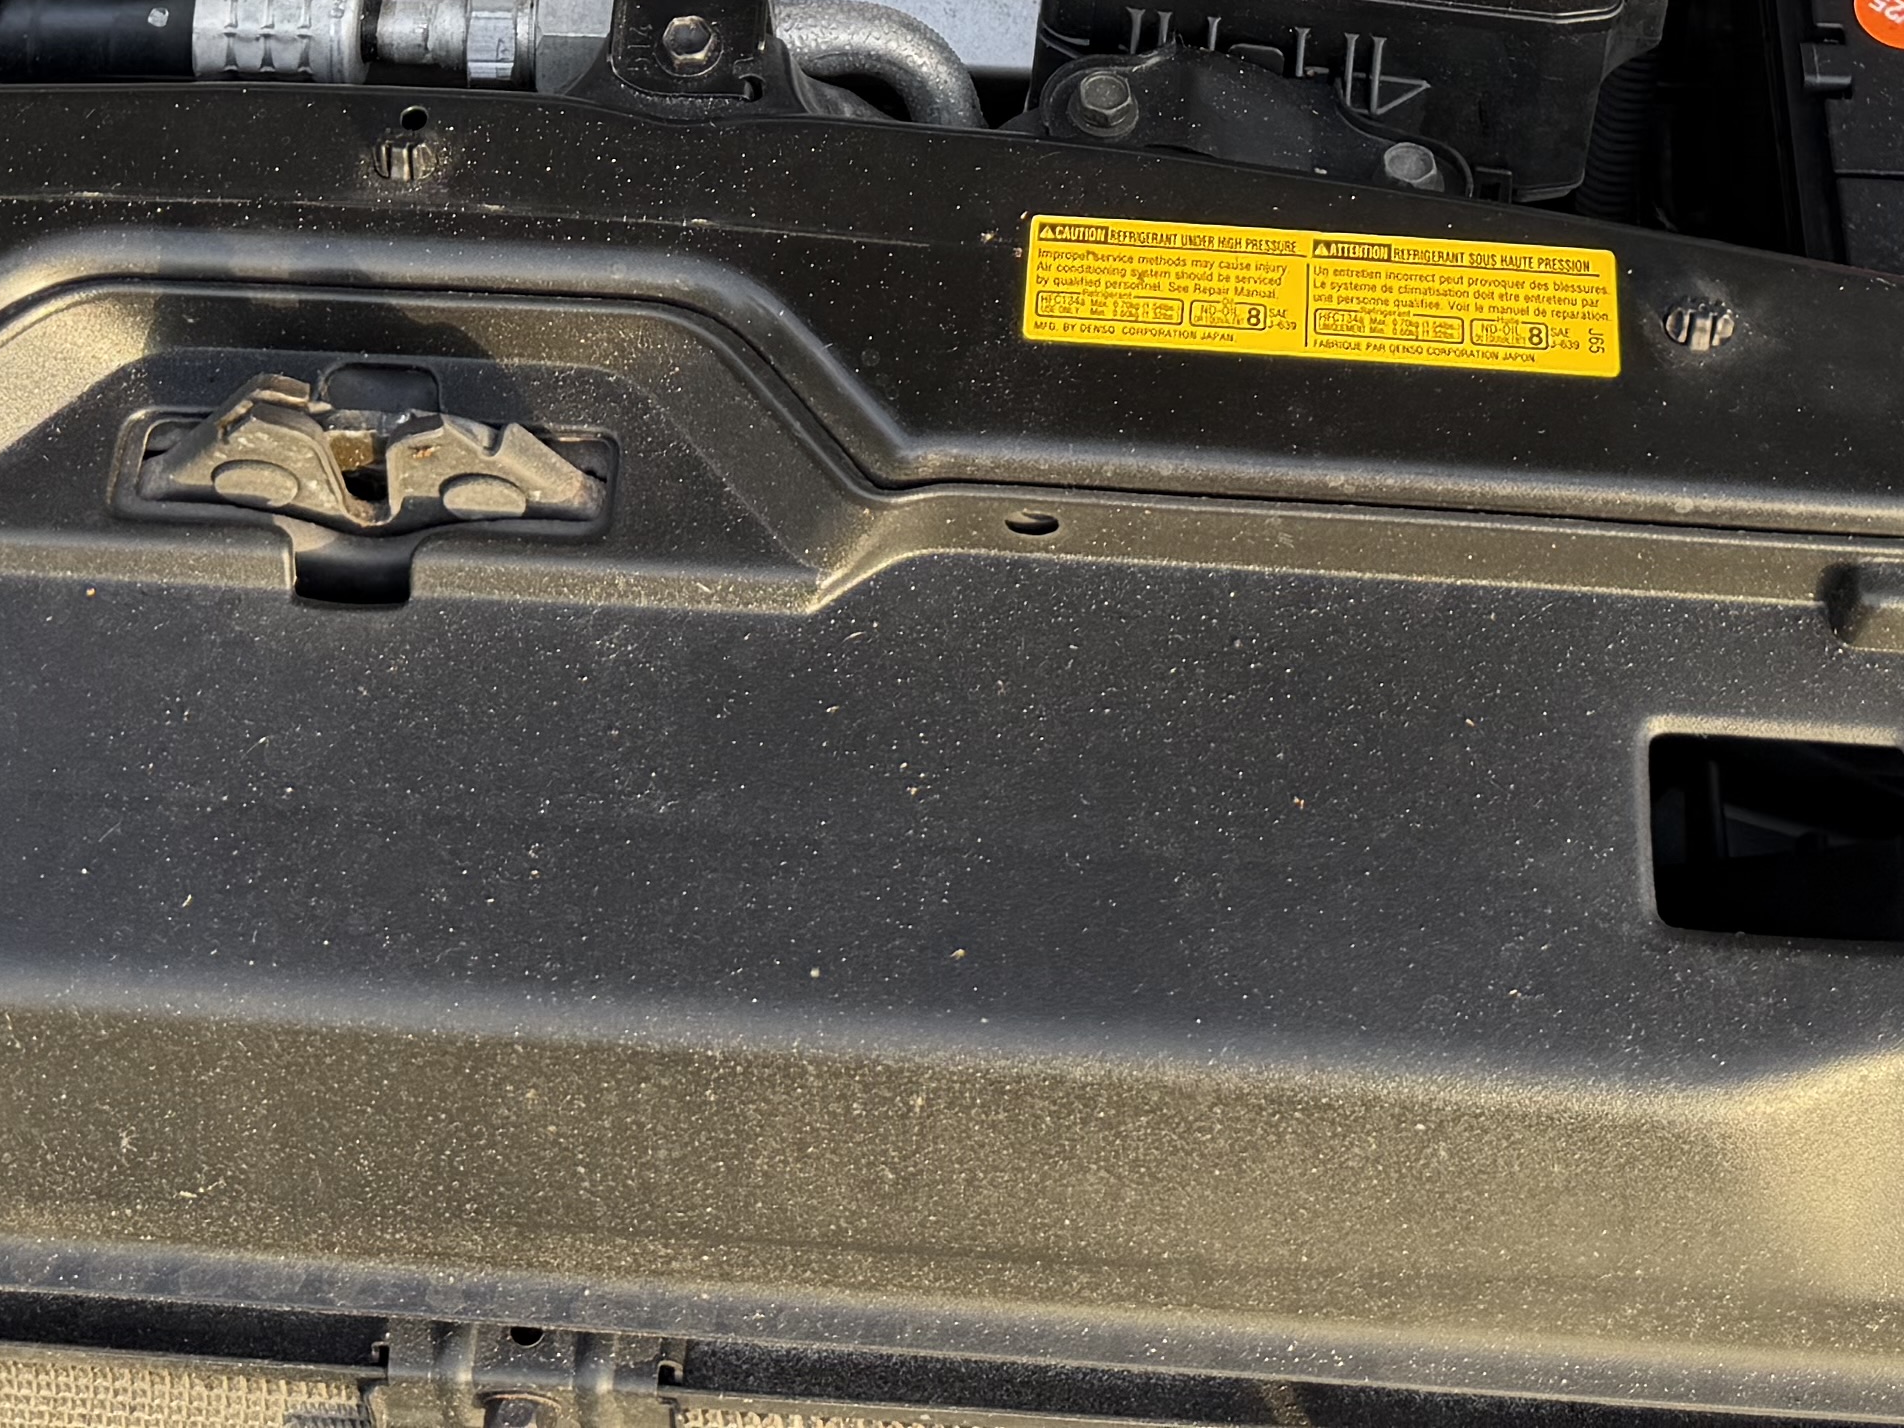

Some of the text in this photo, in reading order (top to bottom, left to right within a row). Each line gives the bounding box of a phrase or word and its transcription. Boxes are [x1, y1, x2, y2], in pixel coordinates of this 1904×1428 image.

[1055, 226, 1297, 252] CAUTION REFRIGERANT UNDER HIGH PRESSURE
[1037, 249, 1088, 266] Improper
[1093, 252, 1134, 264] service
[1138, 253, 1187, 268] methods
[1191, 258, 1215, 271] may
[1218, 259, 1251, 271] cause
[1329, 242, 1590, 273] ATTENTION REFRIGERANT SOUS HAUTE PRESSION
[1036, 262, 1282, 287] Air conditioning system should be serviced
[1036, 275, 1050, 287] by
[1053, 276, 1101, 291] qualified
[1168, 282, 1189, 293] See
[1194, 283, 1229, 298] Repair
[1313, 266, 1328, 278] Un
[1332, 269, 1382, 282] entretien
[1385, 270, 1435, 284] incorrect
[1439, 274, 1464, 287] peut
[1468, 276, 1525, 292] provoquer
[1529, 279, 1549, 291] des
[1313, 279, 1600, 309] Le de climatisation doit entretenu par
[1313, 294, 1547, 318] une personne Voir le manuel de
[1247, 307, 1261, 327] 8
[1269, 308, 1288, 319] SAE
[1063, 323, 1197, 340] BY DENSO CORPORATION
[1528, 326, 1543, 346] 8
[1550, 327, 1570, 338] SAE
[1588, 328, 1605, 355] J65
[1313, 339, 1536, 363] FABRIQUE PAR DENSO CORPORATION JAPON
